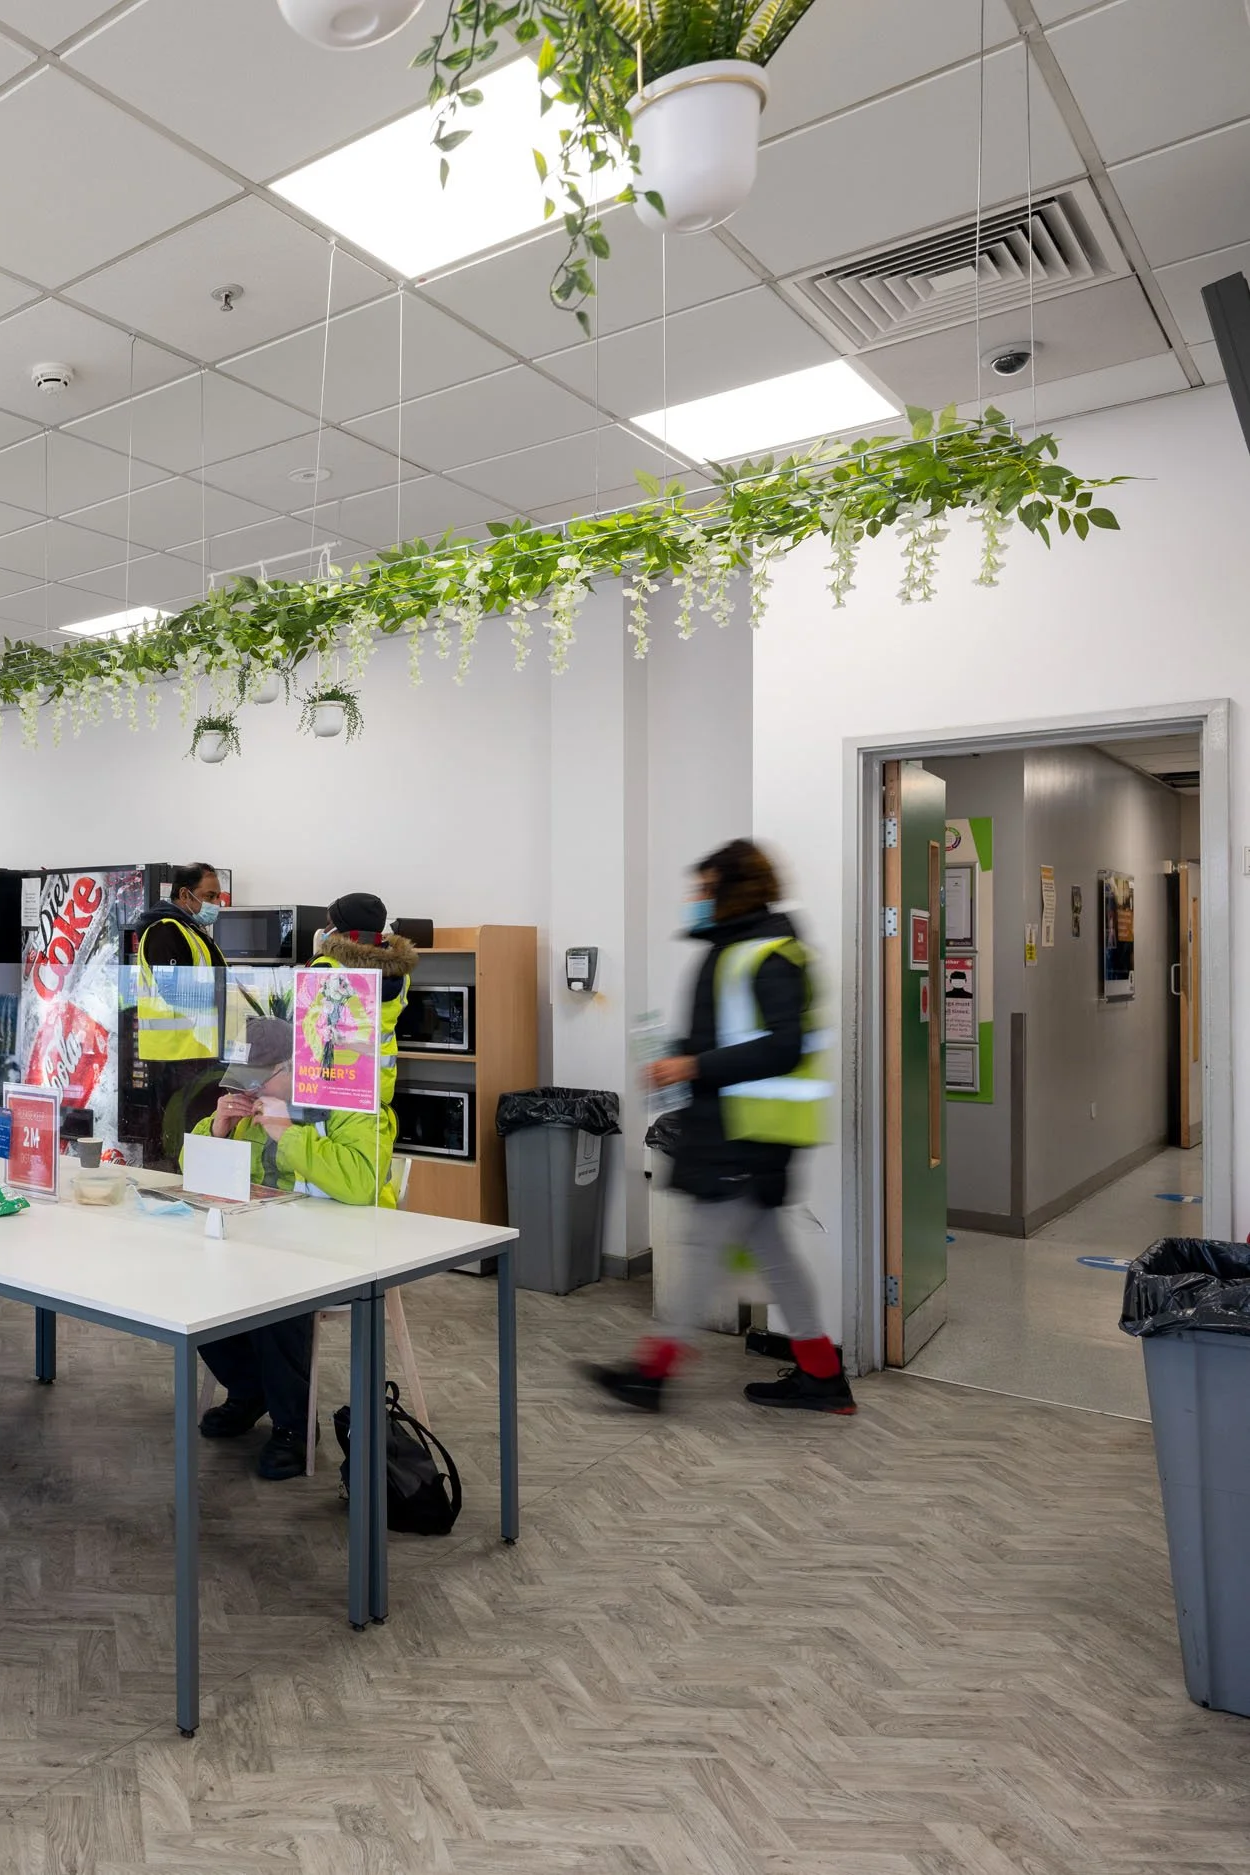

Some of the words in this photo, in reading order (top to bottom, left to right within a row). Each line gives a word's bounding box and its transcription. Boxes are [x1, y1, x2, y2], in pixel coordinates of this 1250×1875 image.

[33, 877, 102, 1001] Coke
[298, 1066, 356, 1081] MOTHER'S
[298, 1082, 319, 1094] DAY
[23, 1126, 40, 1149] 2M
